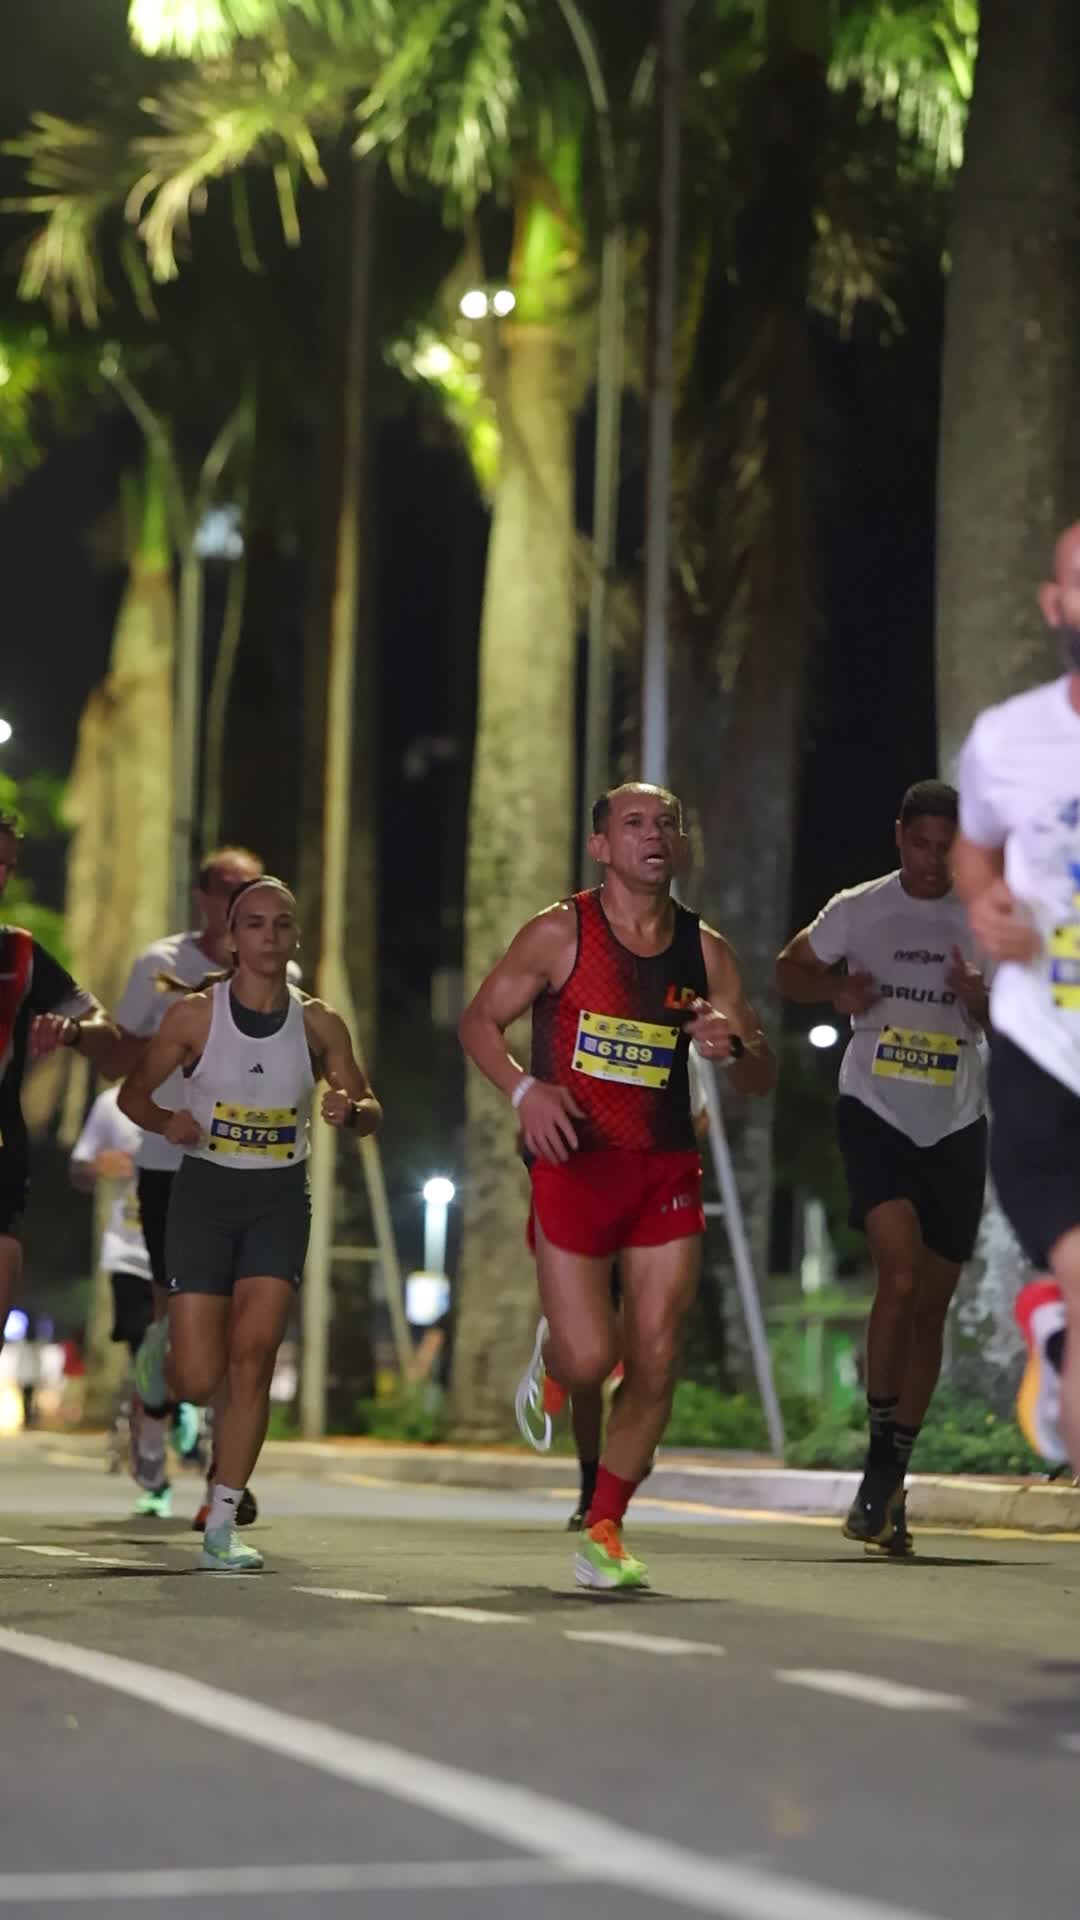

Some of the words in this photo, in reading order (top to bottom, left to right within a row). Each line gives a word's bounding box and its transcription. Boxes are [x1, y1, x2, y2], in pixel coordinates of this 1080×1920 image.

[597, 1040, 653, 1063] 6189
[895, 1048, 939, 1067] 6031
[229, 1126, 279, 1143] 6176
